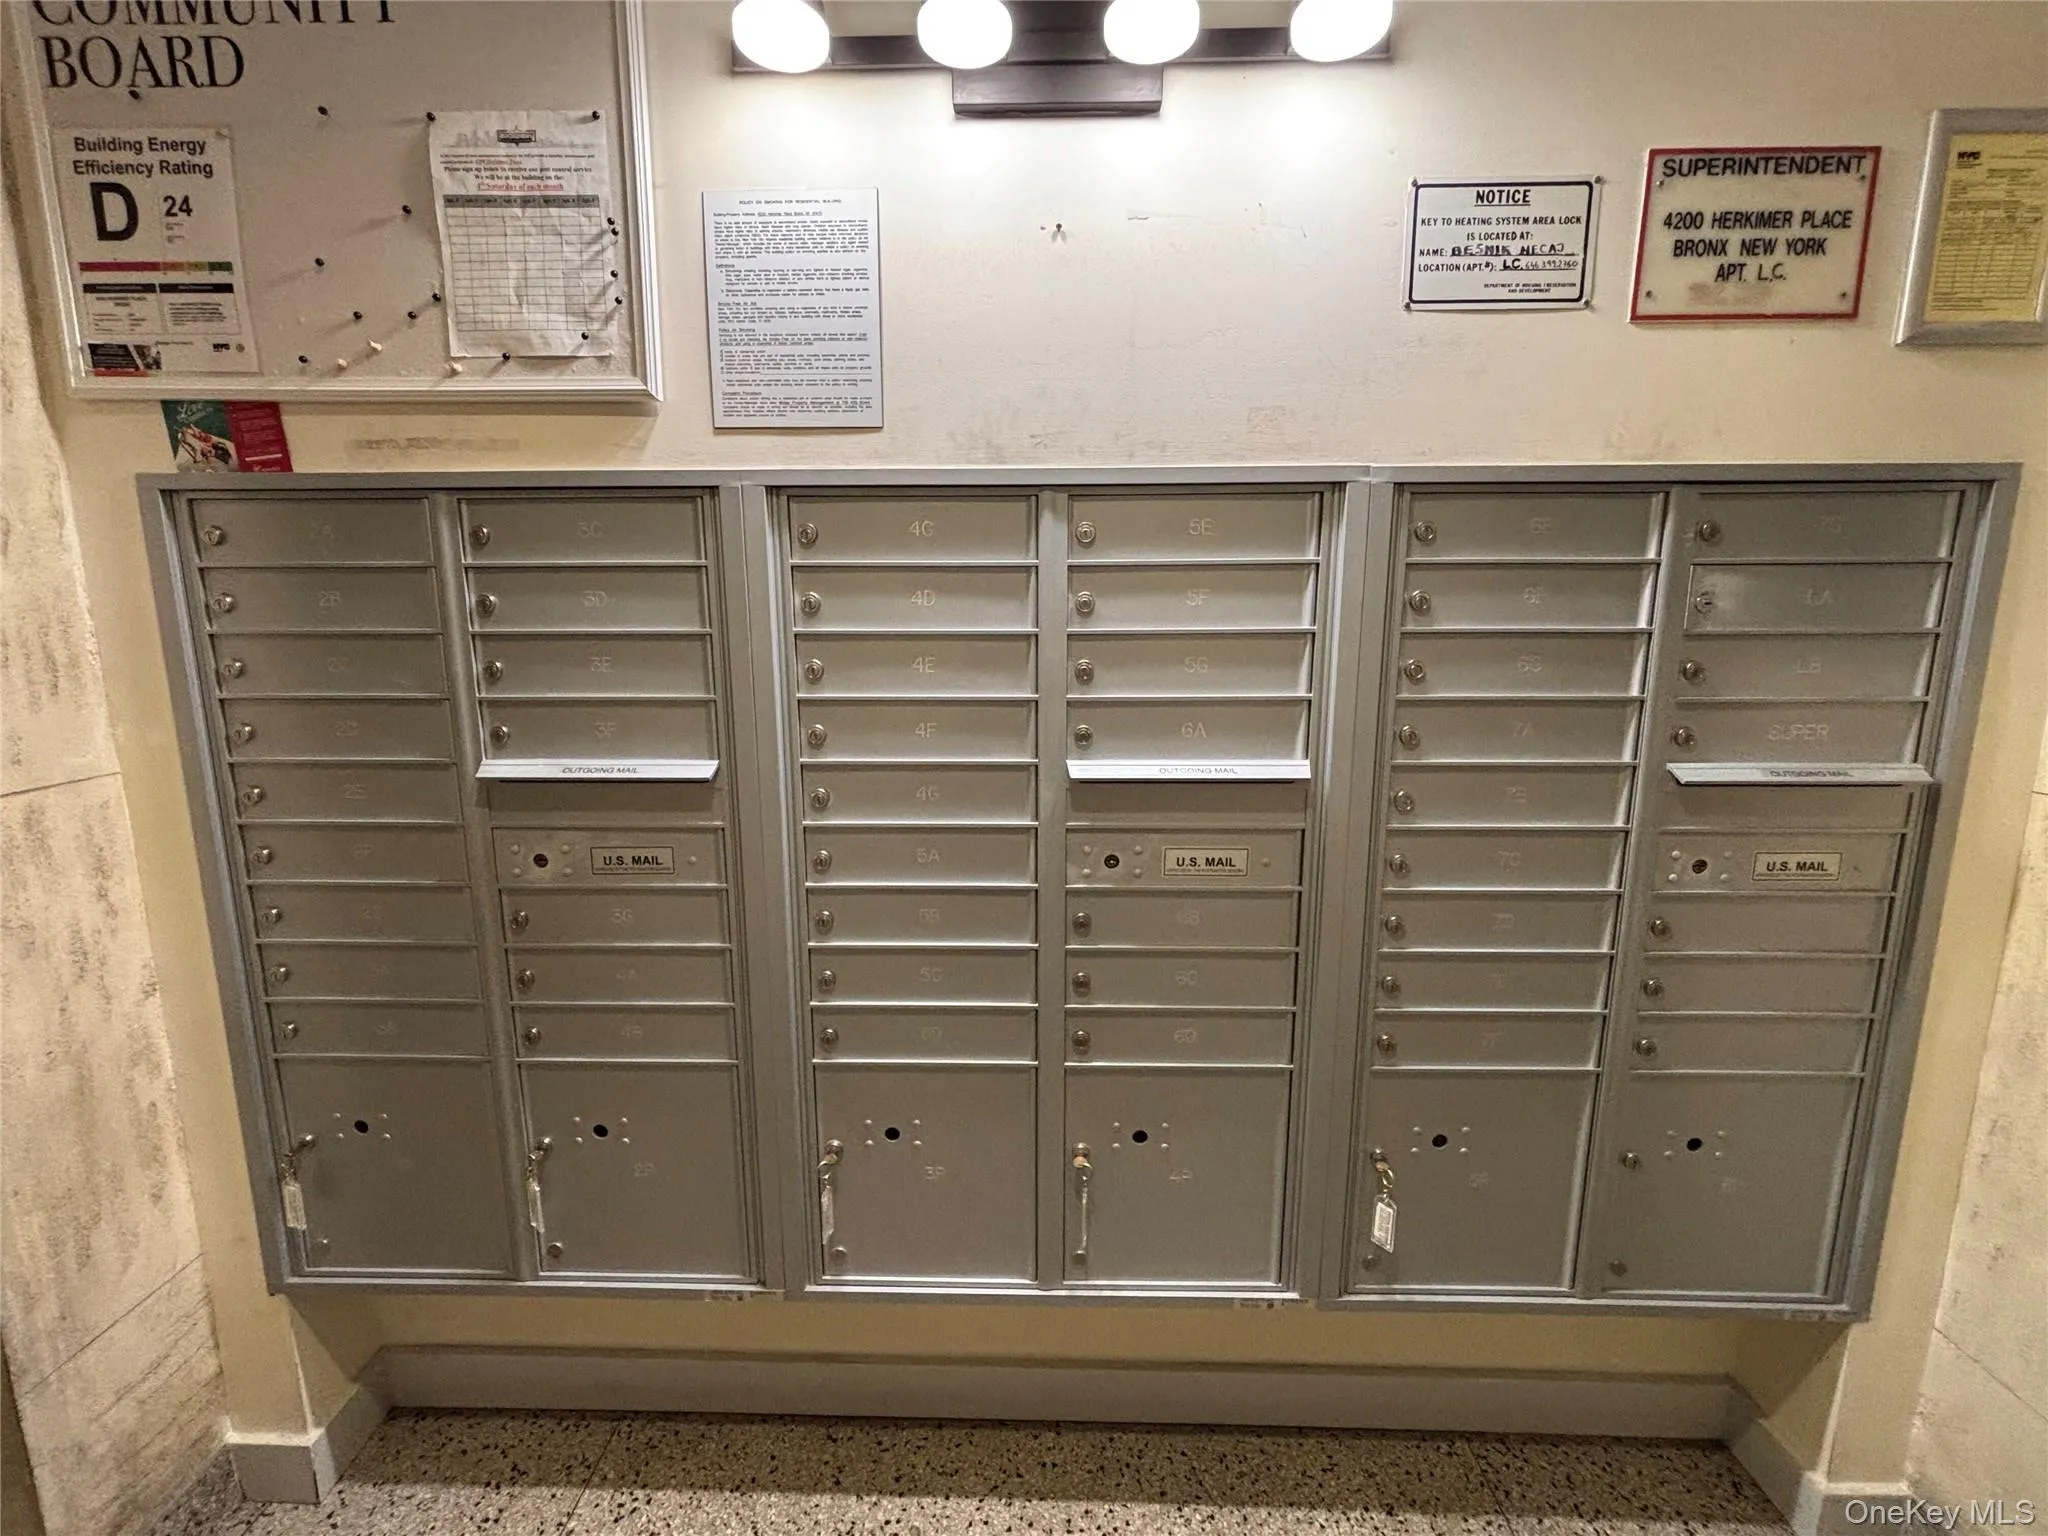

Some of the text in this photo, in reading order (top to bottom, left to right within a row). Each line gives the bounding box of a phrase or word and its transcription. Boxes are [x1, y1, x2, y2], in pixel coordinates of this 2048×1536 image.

[38, 36, 244, 88] BOARD
[74, 136, 206, 155] Building Energy
[73, 160, 213, 178] Efficiency Rating
[1663, 155, 1867, 177] SUPERINTENDENT
[1475, 190, 1531, 204] NOTICE
[90, 182, 139, 241] D
[163, 195, 193, 217] 24
[1421, 215, 1582, 226] KEY TO HEATING SYSTEM AREA LOCK
[1663, 210, 1853, 229] 4200 HERKIMER PLACE
[1467, 231, 1534, 241] IS LOCATED AT:
[1419, 248, 1448, 257] NAME:
[1673, 238, 1828, 257] BRONX NEW YORK
[1418, 263, 1460, 272] LOCATION
[1715, 263, 1787, 282] APT. L.C.
[1188, 518, 1216, 536] 5E
[911, 589, 935, 606] 4D
[1186, 588, 1211, 605] 5F
[589, 656, 613, 672] 3E
[912, 656, 936, 673] 4E
[1184, 656, 1209, 673] 5G
[593, 722, 617, 739] 3F
[914, 722, 938, 739] 4F
[1181, 721, 1207, 738] 6A
[915, 785, 940, 801] 4G
[603, 855, 664, 866] U.S. MAIL
[915, 847, 940, 863] 5A
[1176, 856, 1237, 868] U.S. MAIL
[1766, 861, 1829, 872] U.S. MAIL
